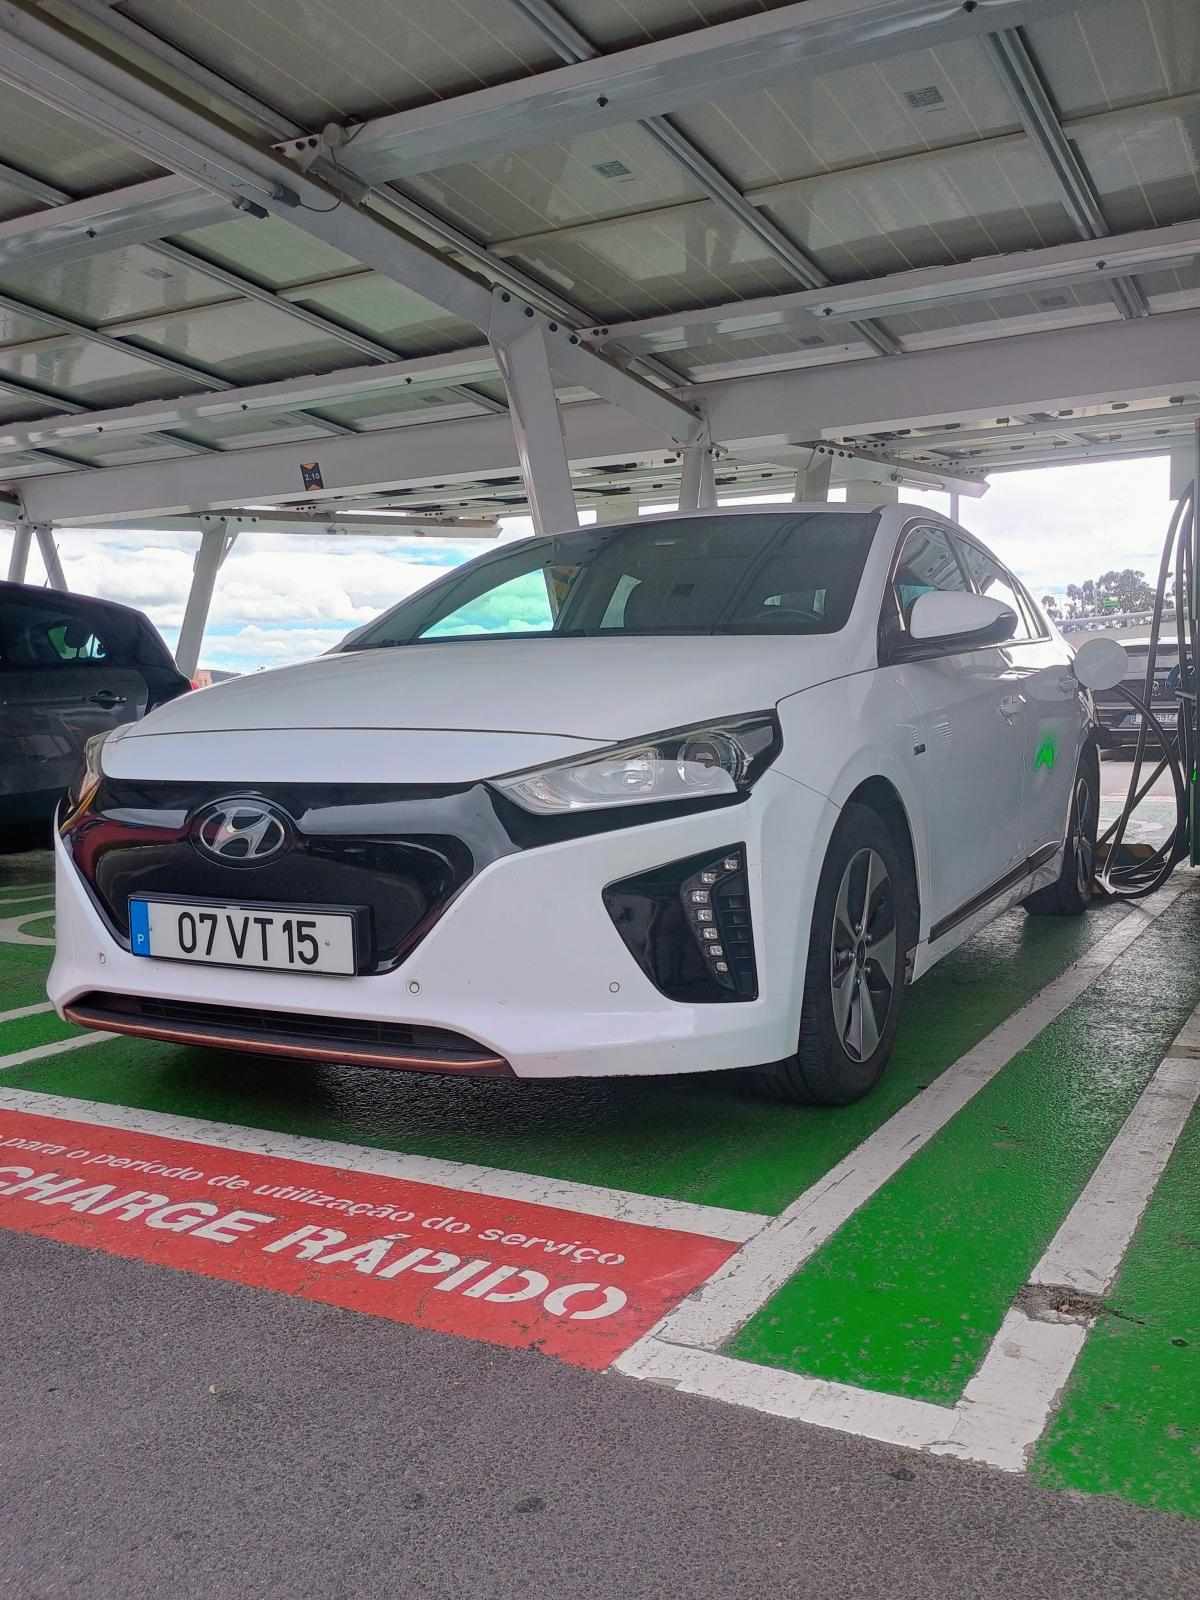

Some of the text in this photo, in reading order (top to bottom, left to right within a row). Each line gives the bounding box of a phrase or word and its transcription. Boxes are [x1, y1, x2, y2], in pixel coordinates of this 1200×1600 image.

[137, 934, 145, 945] P
[0, 1137, 625, 1265] para o período de utilização do serviço
[261, 1224, 628, 1320] RÁPIDO
